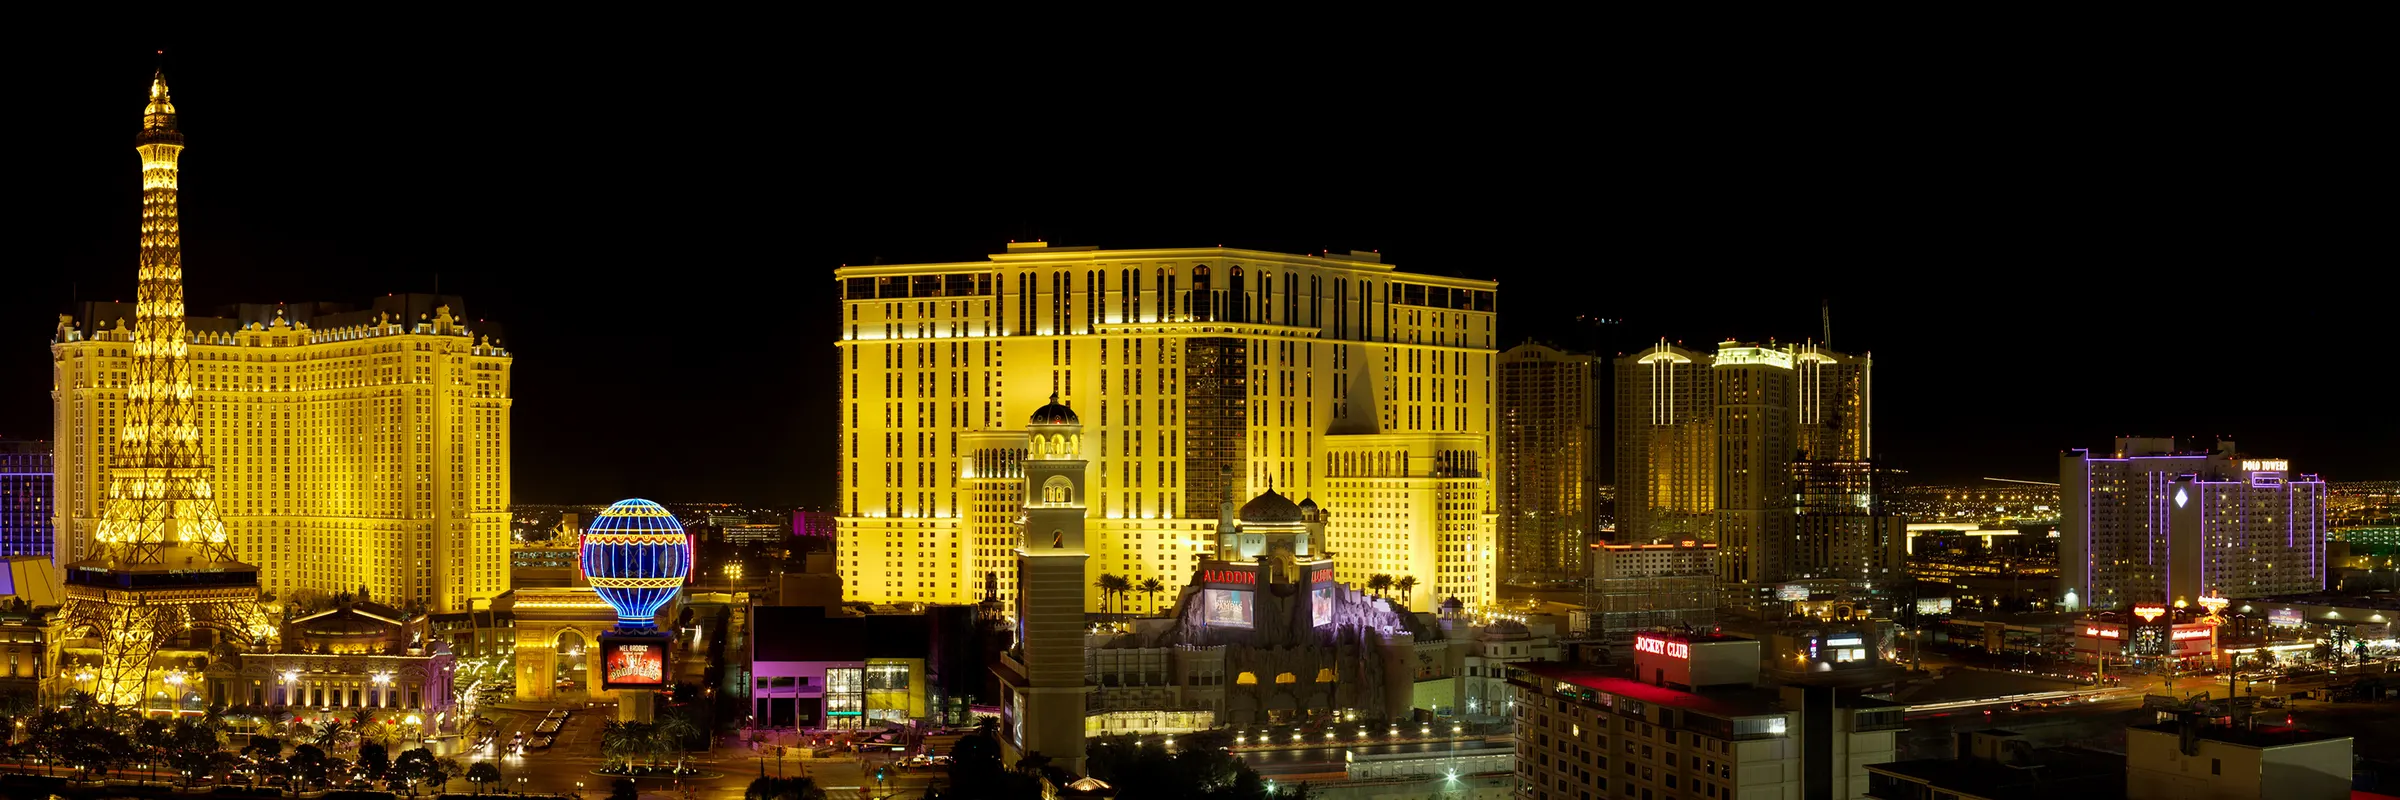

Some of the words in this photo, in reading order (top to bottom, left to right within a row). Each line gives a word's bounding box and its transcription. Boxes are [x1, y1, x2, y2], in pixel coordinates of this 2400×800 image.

[2242, 460, 2261, 471] POLO
[2262, 460, 2288, 471] TOWERS
[1203, 569, 1256, 585] ALADDIN
[1214, 602, 1243, 612] PAMPAS
[1635, 636, 1665, 654] JOCKEY
[1667, 642, 1688, 659] CLUB
[610, 666, 659, 681] PRODUCERS
